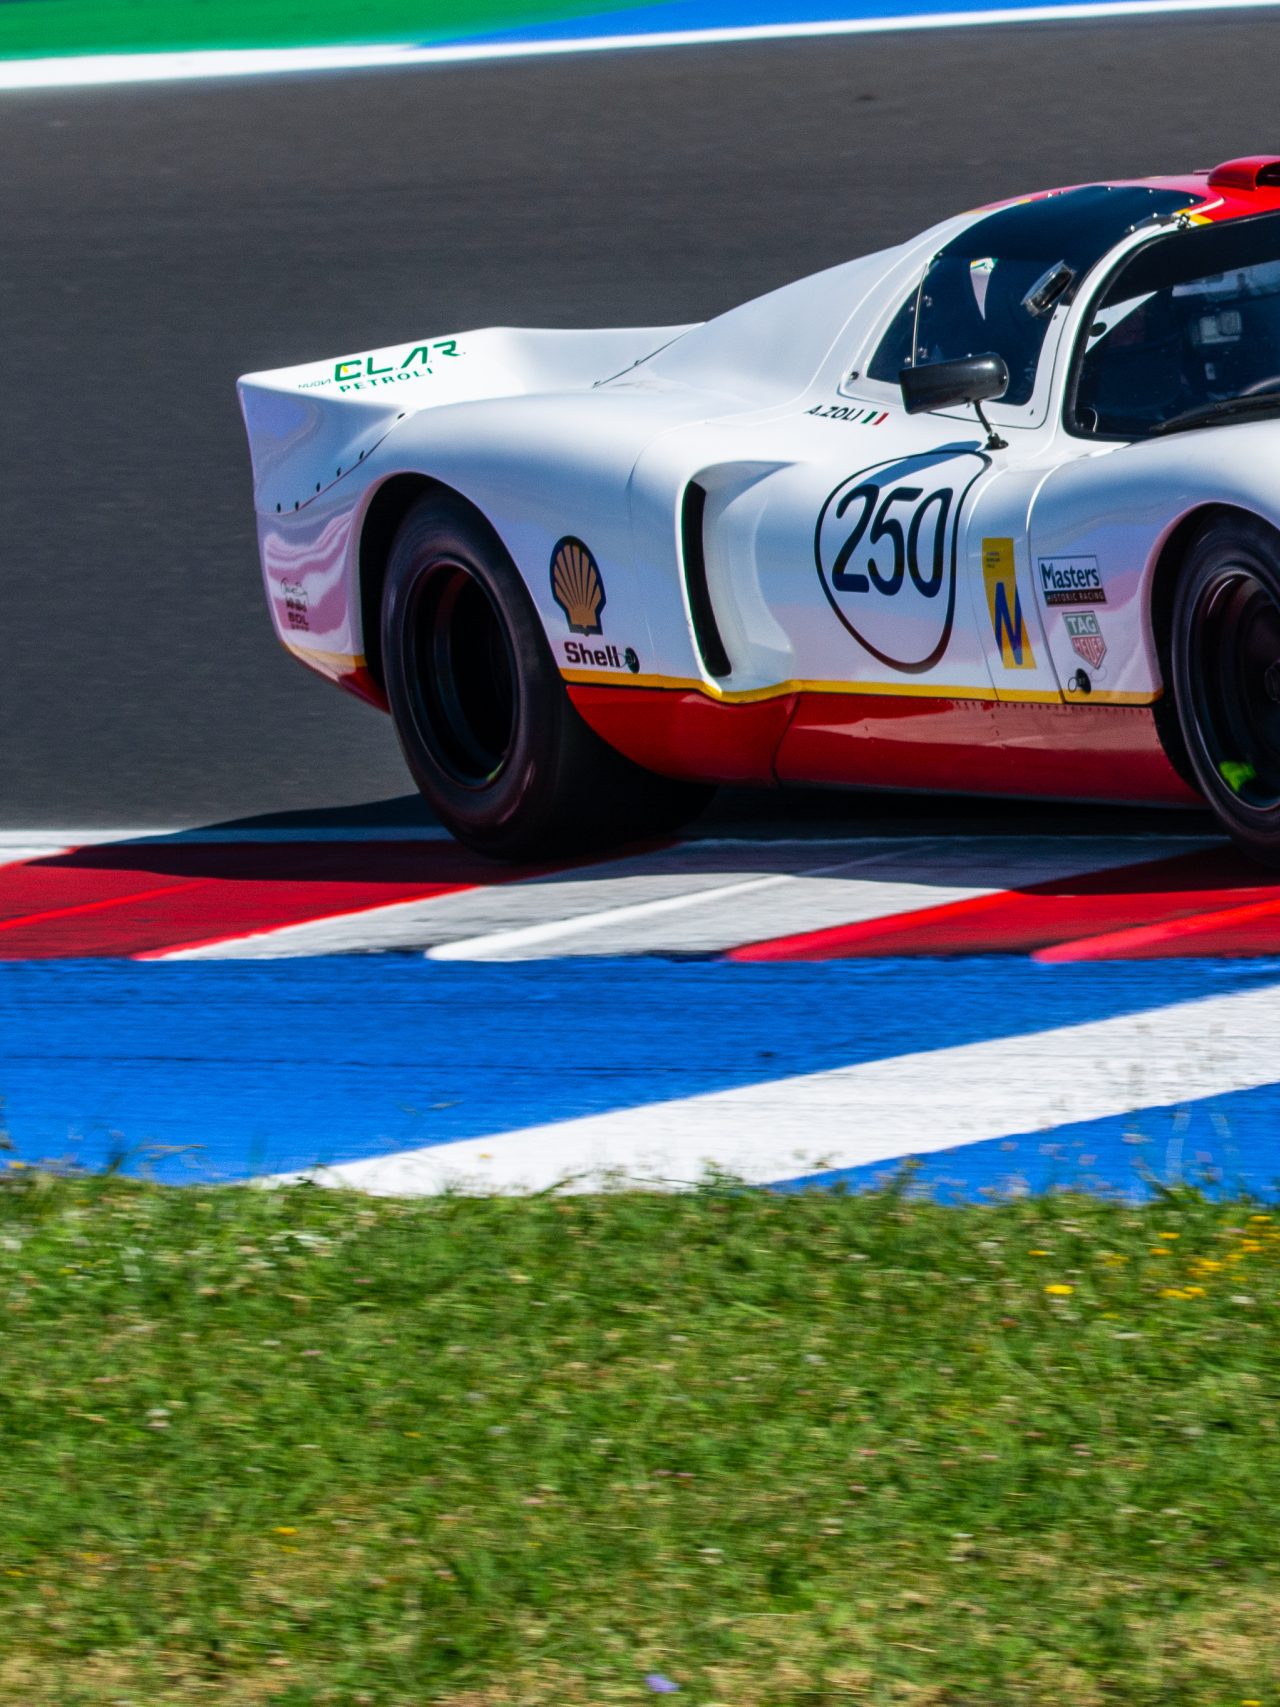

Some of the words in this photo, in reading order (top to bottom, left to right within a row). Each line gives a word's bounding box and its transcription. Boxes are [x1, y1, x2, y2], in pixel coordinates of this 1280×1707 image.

[339, 367, 434, 393] PETROLI
[831, 483, 954, 599] 250
[1040, 562, 1101, 590] Masters
[1046, 592, 1078, 603] HISTORIC
[1078, 590, 1105, 602] RACING
[1067, 615, 1098, 635] TAG
[563, 641, 621, 669] Shell
[1073, 637, 1102, 663] HEUER
